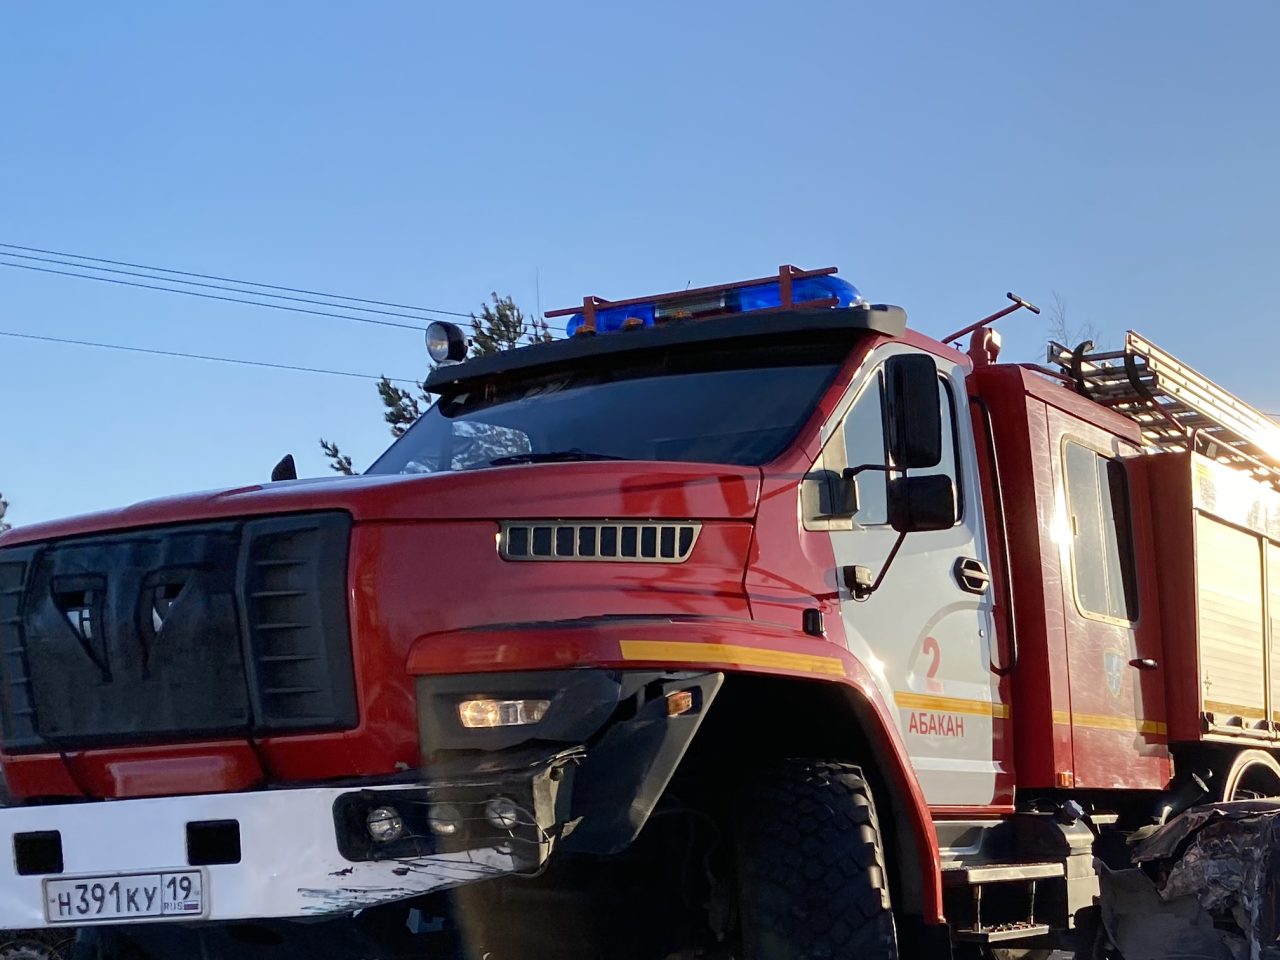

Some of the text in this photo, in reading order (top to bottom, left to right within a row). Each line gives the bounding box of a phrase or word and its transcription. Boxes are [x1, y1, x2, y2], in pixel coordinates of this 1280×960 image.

[922, 636, 944, 693] 2
[908, 711, 964, 737] АБАКАН
[58, 875, 192, 916] Н391КУ 19
[163, 901, 183, 911] RUS
